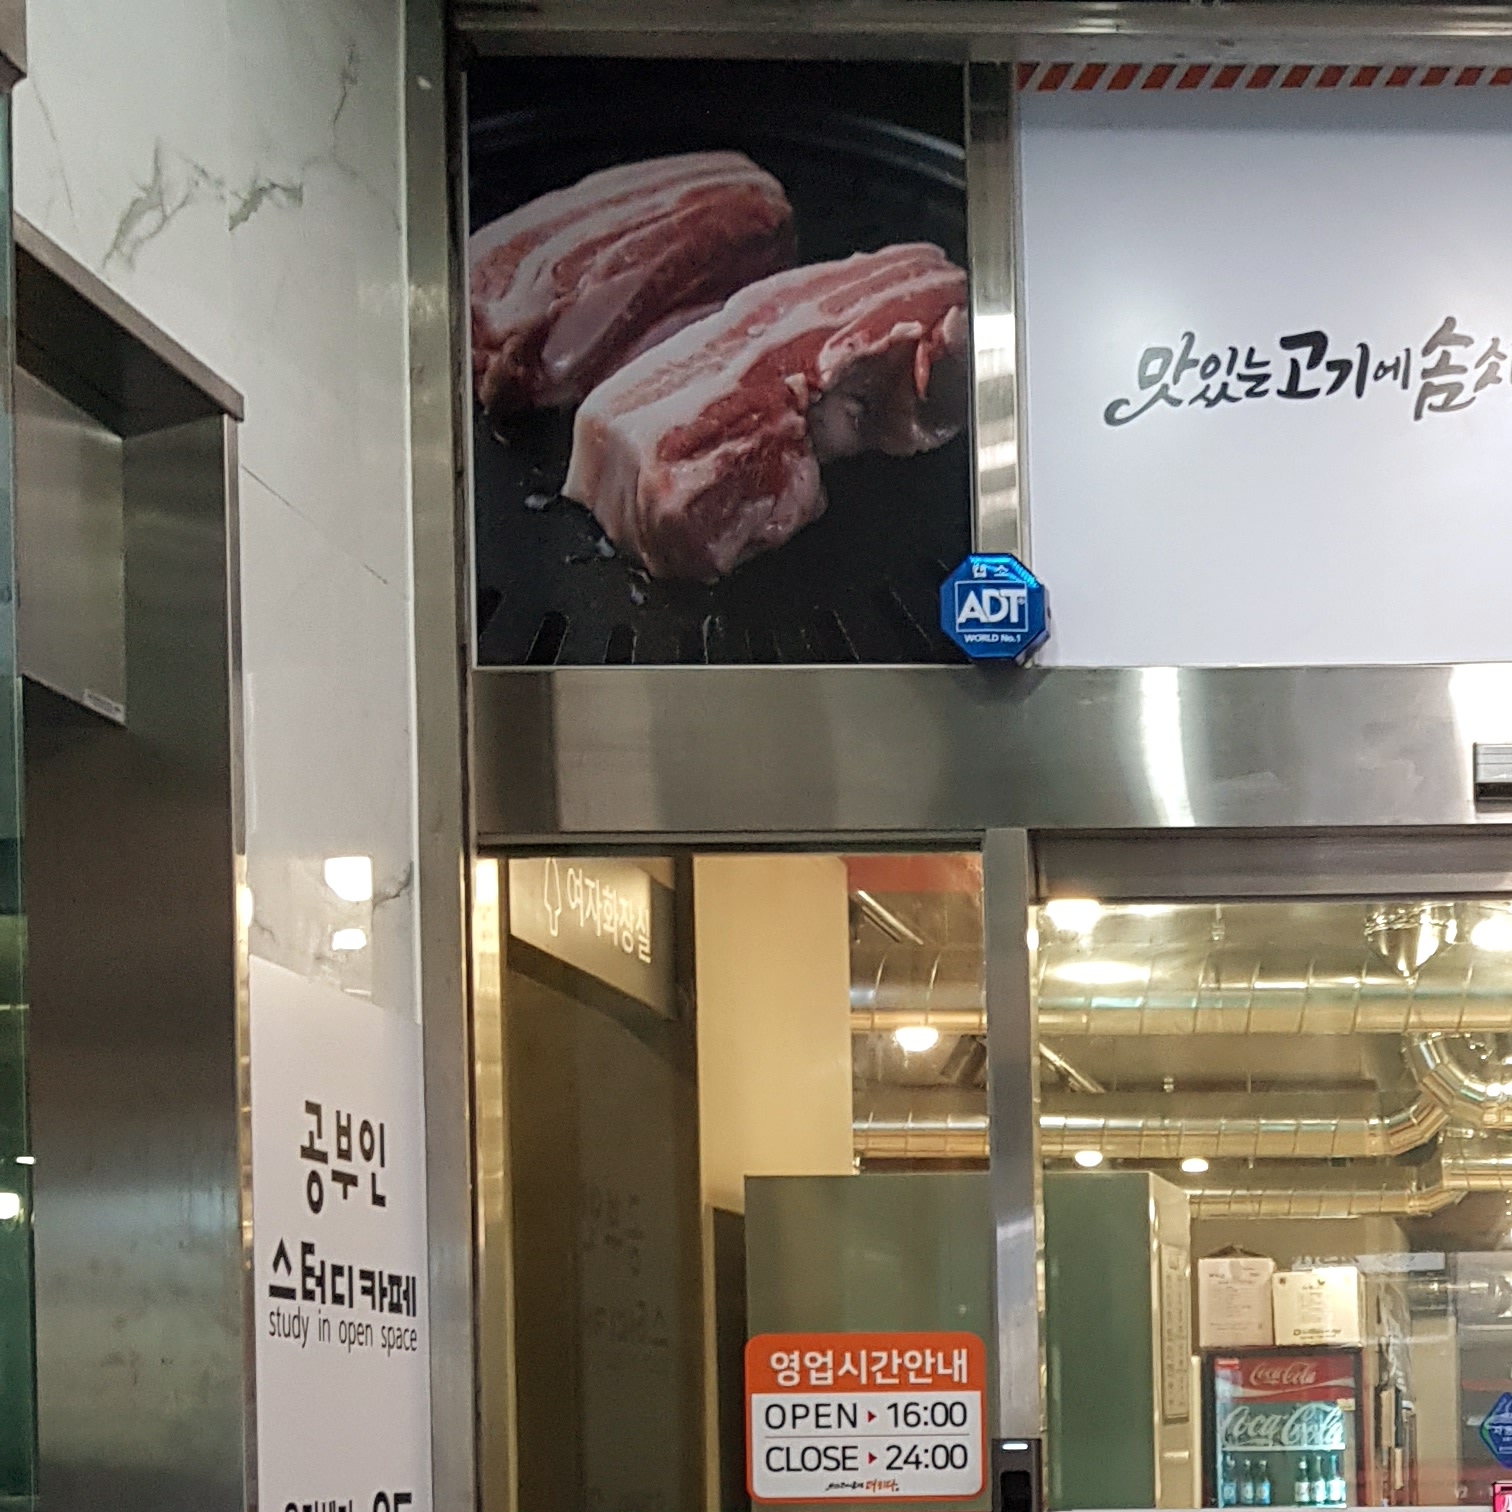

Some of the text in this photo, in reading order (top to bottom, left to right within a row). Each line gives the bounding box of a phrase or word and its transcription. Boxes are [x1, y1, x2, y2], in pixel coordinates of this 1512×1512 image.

[957, 588, 1026, 623] ADT
[963, 633, 1000, 643] WORLD
[567, 868, 651, 964] 여자화장실
[300, 1099, 386, 1214] 공부인
[268, 1236, 417, 1318] 스터디카페
[269, 1306, 418, 1358] study in open space
[770, 1349, 968, 1387] 영업시간안내
[765, 1402, 967, 1430] OPEN 16:00
[765, 1444, 968, 1472] CLOSE 24:00
